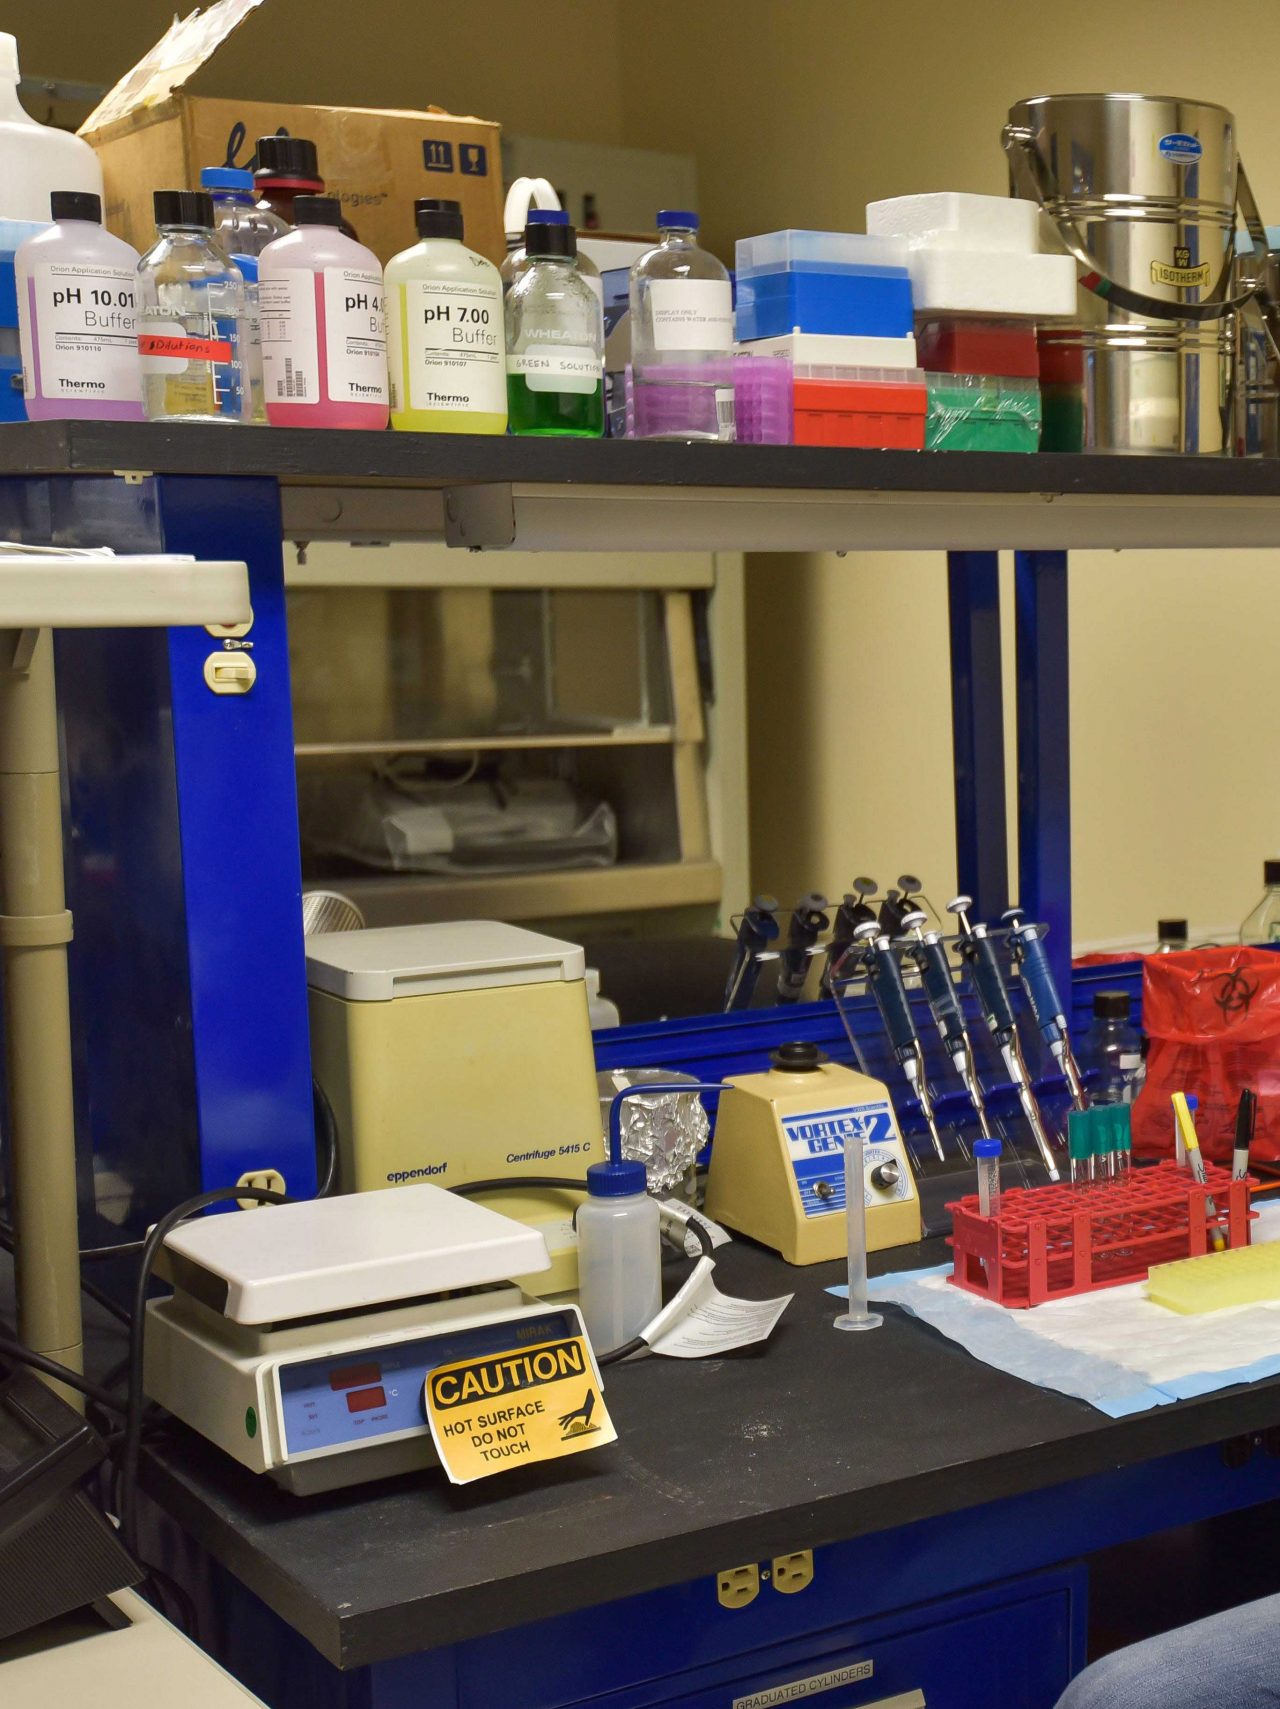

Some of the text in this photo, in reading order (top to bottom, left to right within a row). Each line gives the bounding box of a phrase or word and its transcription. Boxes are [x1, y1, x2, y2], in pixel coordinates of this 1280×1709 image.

[50, 265, 70, 273] Orion
[71, 266, 111, 276] Application
[1159, 267, 1203, 282] ISOTHERM
[53, 288, 135, 308] pH 10.01
[442, 285, 477, 294] Application
[345, 294, 367, 312] pH
[85, 311, 136, 329] Buffer
[424, 306, 489, 324] pH 7.00
[229, 333, 240, 342] 150
[453, 328, 497, 345] Buffer
[156, 339, 210, 354] Dilutions
[231, 360, 242, 369] 100
[516, 359, 550, 368] GREEN
[59, 379, 105, 389] Thermo
[348, 383, 382, 394] Thermo
[427, 392, 470, 402] Thermo
[864, 1112, 897, 1144] 2
[506, 1142, 591, 1164] Centrifuge 5415 C
[387, 1163, 448, 1183] eppendorf
[434, 1345, 582, 1405] CAUTION
[443, 1401, 545, 1437] HOT SURFACE
[471, 1423, 526, 1448] DO NOT
[480, 1441, 531, 1462] TOUCH
[736, 1664, 871, 1709] GRADUATED CYLINDERS
